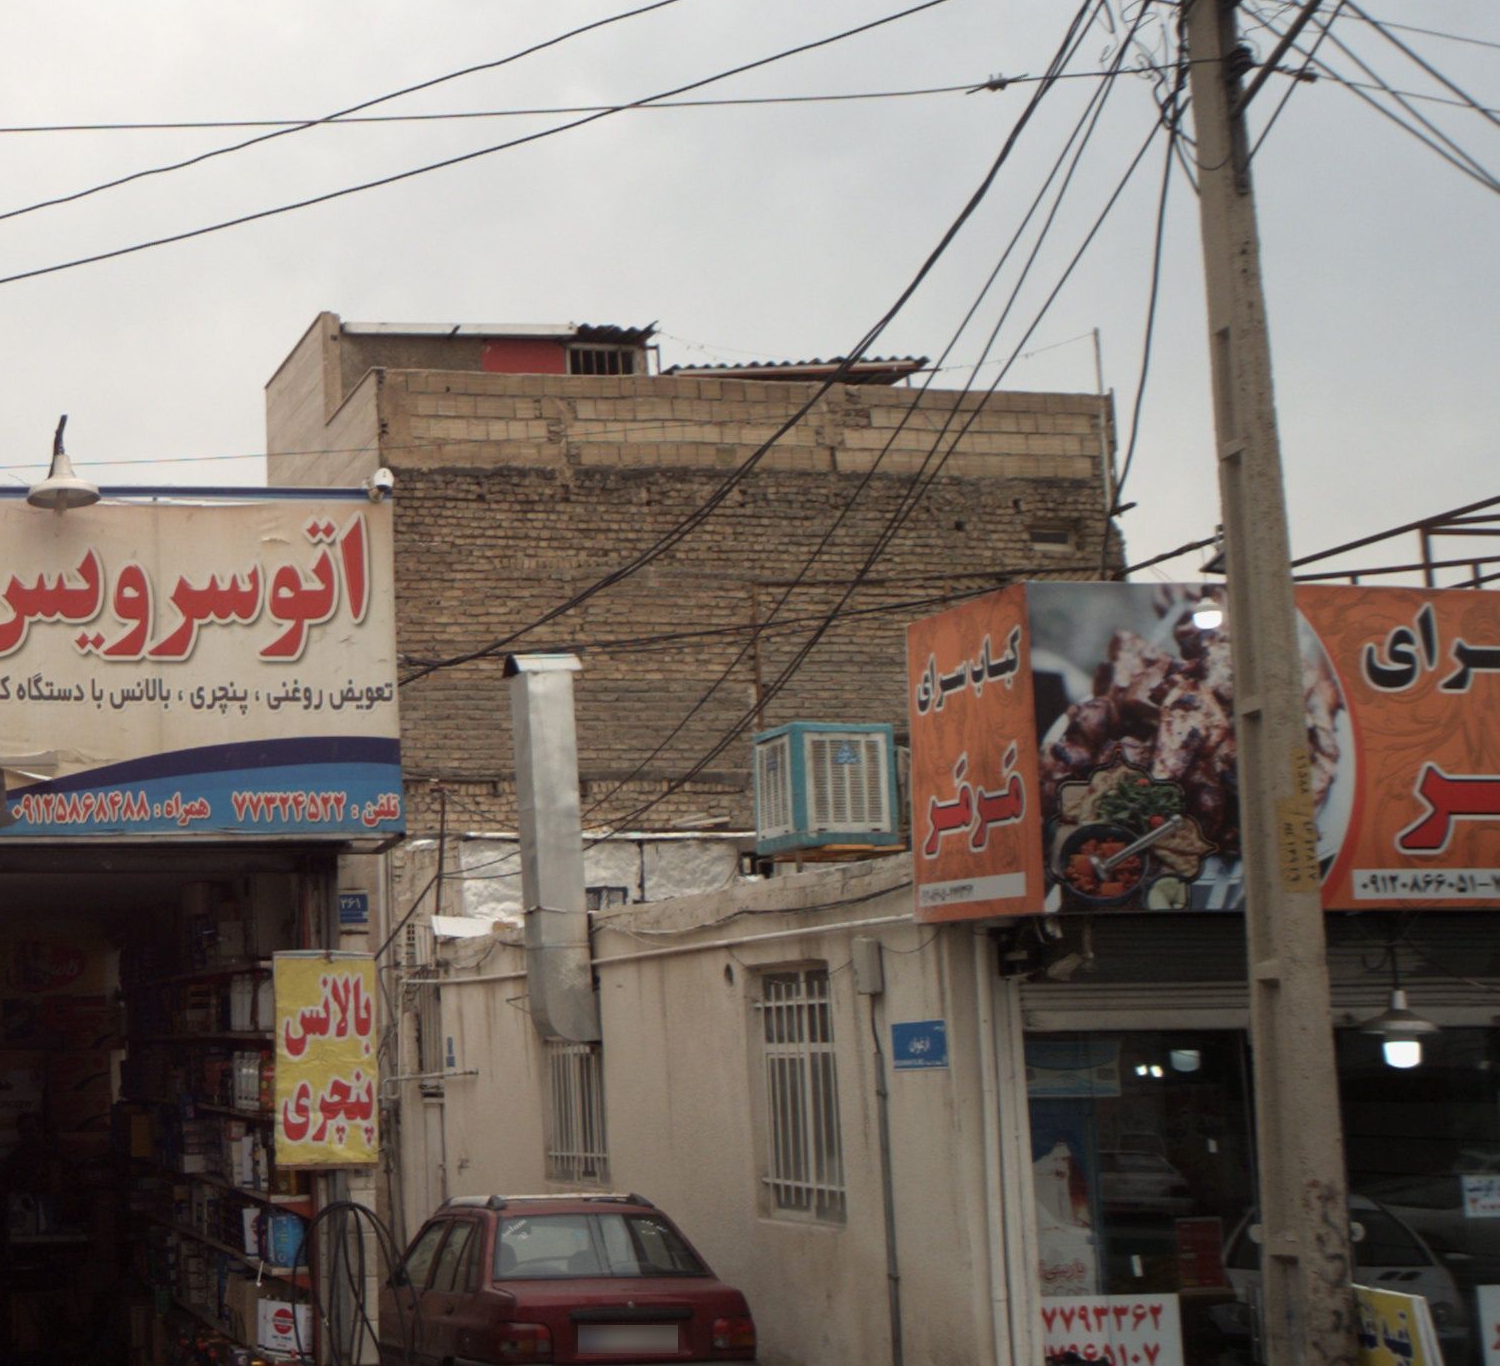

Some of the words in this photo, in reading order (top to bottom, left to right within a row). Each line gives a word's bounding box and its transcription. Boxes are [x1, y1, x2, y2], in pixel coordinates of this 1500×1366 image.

[970, 624, 1020, 690] کباب
[17, 673, 84, 702] دستگاه
[92, 678, 104, 709] با
[110, 678, 171, 710] بالانس
[329, 679, 393, 710] تعویض
[917, 653, 968, 713] سرای
[284, 976, 372, 1057] بالانس
[282, 1071, 375, 1145] پنچری
